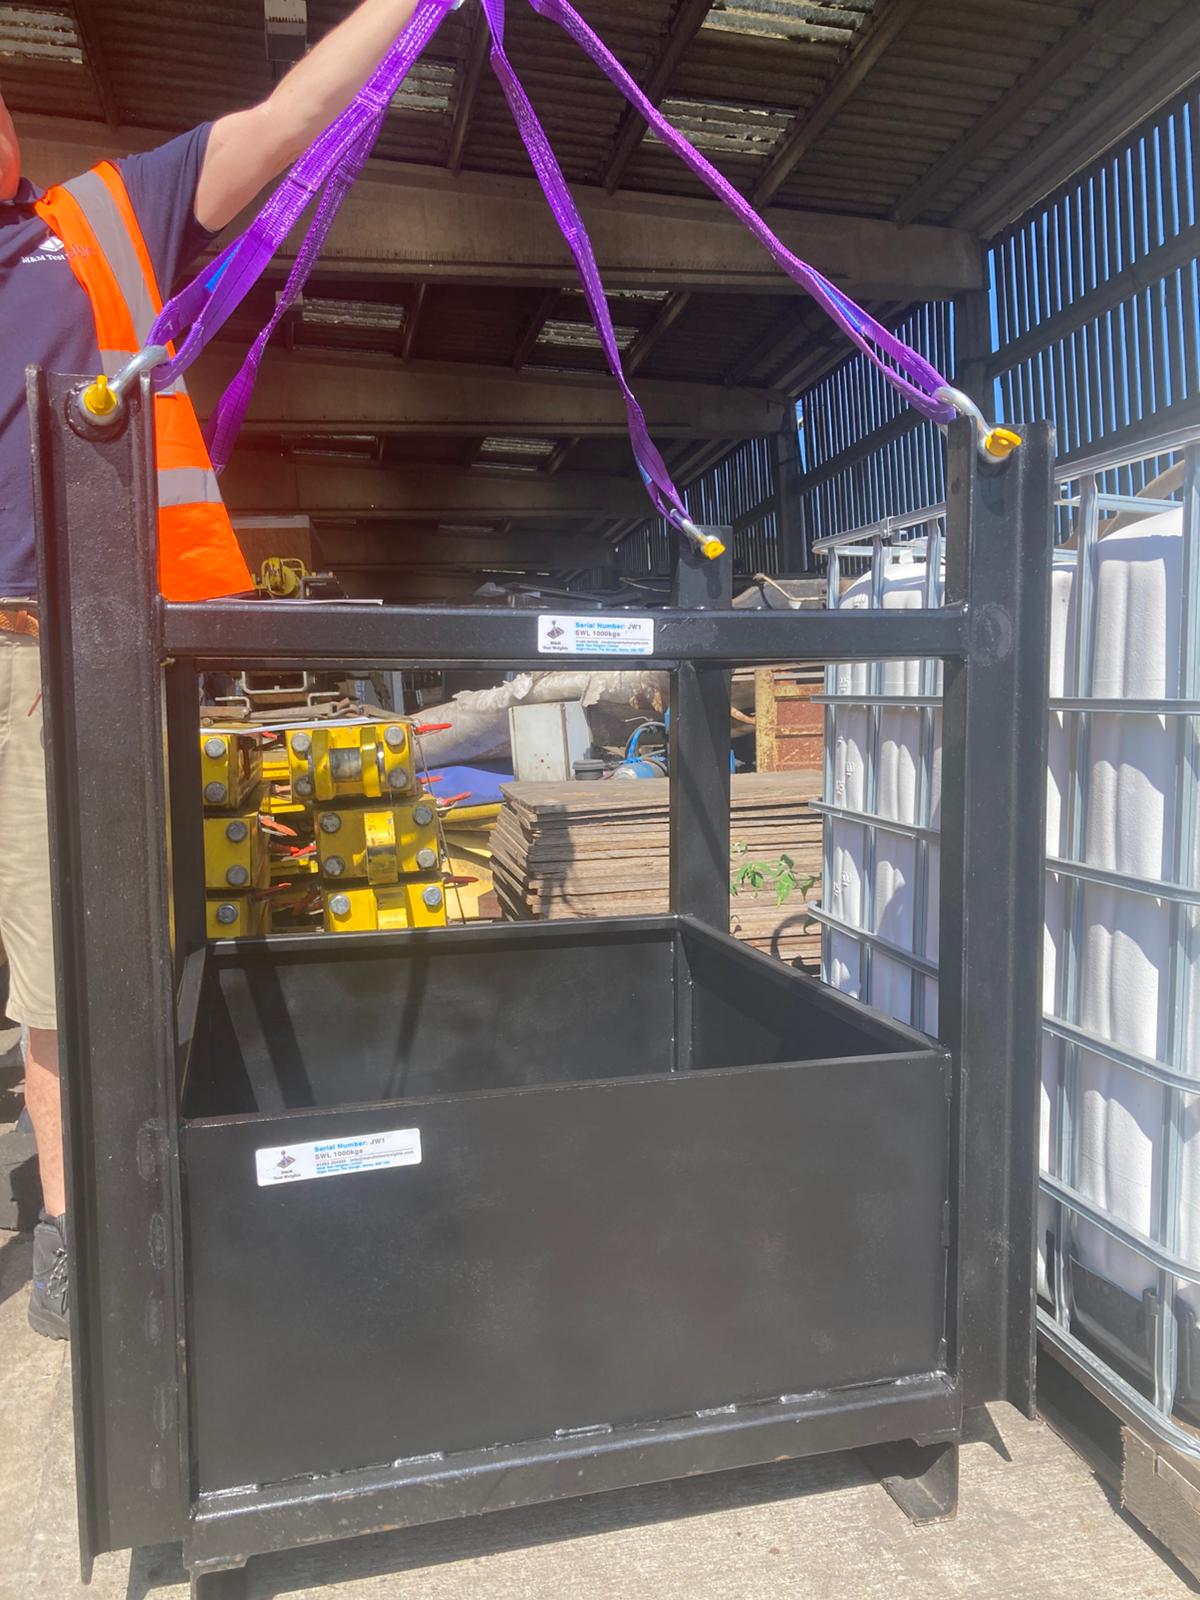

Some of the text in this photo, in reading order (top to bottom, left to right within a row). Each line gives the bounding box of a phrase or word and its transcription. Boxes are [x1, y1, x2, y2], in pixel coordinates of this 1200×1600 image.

[593, 630, 621, 638] 1000kgs
[314, 1137, 385, 1152] Serial Number: JW1
[334, 1149, 363, 1158] 1000kgs
